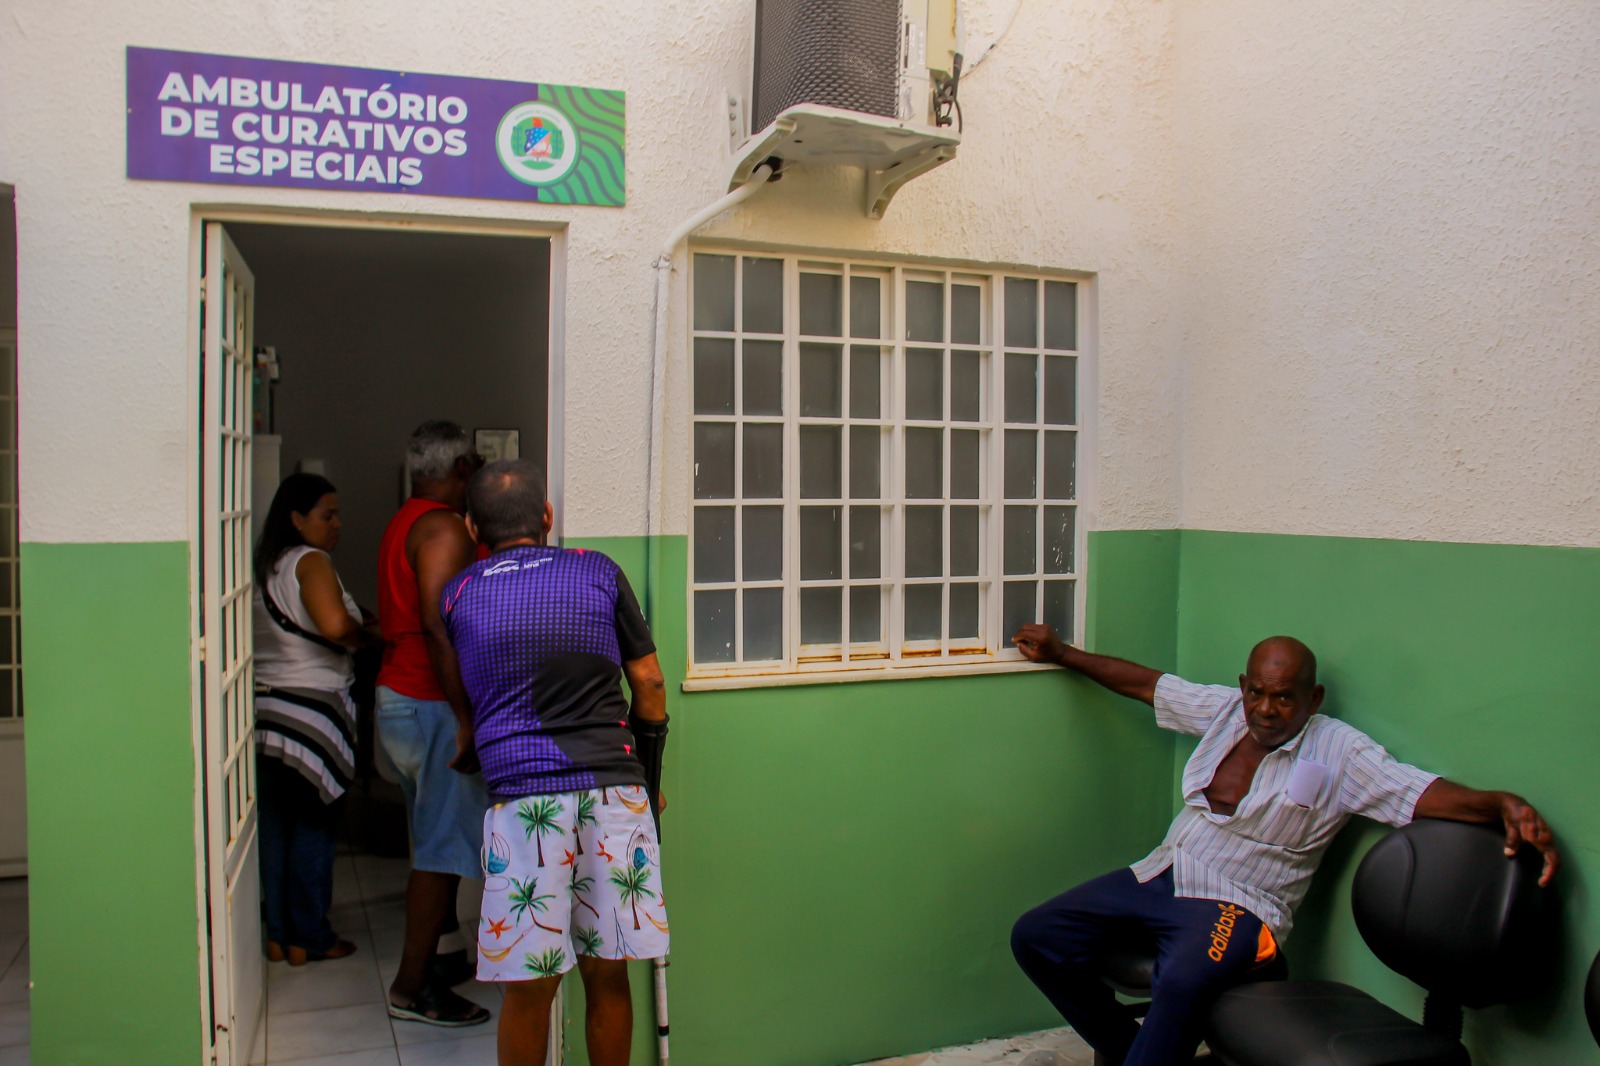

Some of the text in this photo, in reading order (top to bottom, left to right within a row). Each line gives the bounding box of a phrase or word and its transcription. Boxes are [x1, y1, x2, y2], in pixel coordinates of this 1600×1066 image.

[157, 72, 469, 124] AMBULATÓRIO
[160, 106, 469, 157] DE CURATIVOS
[209, 144, 424, 186] ESPECIAIS
[1207, 911, 1237, 962] adidas
